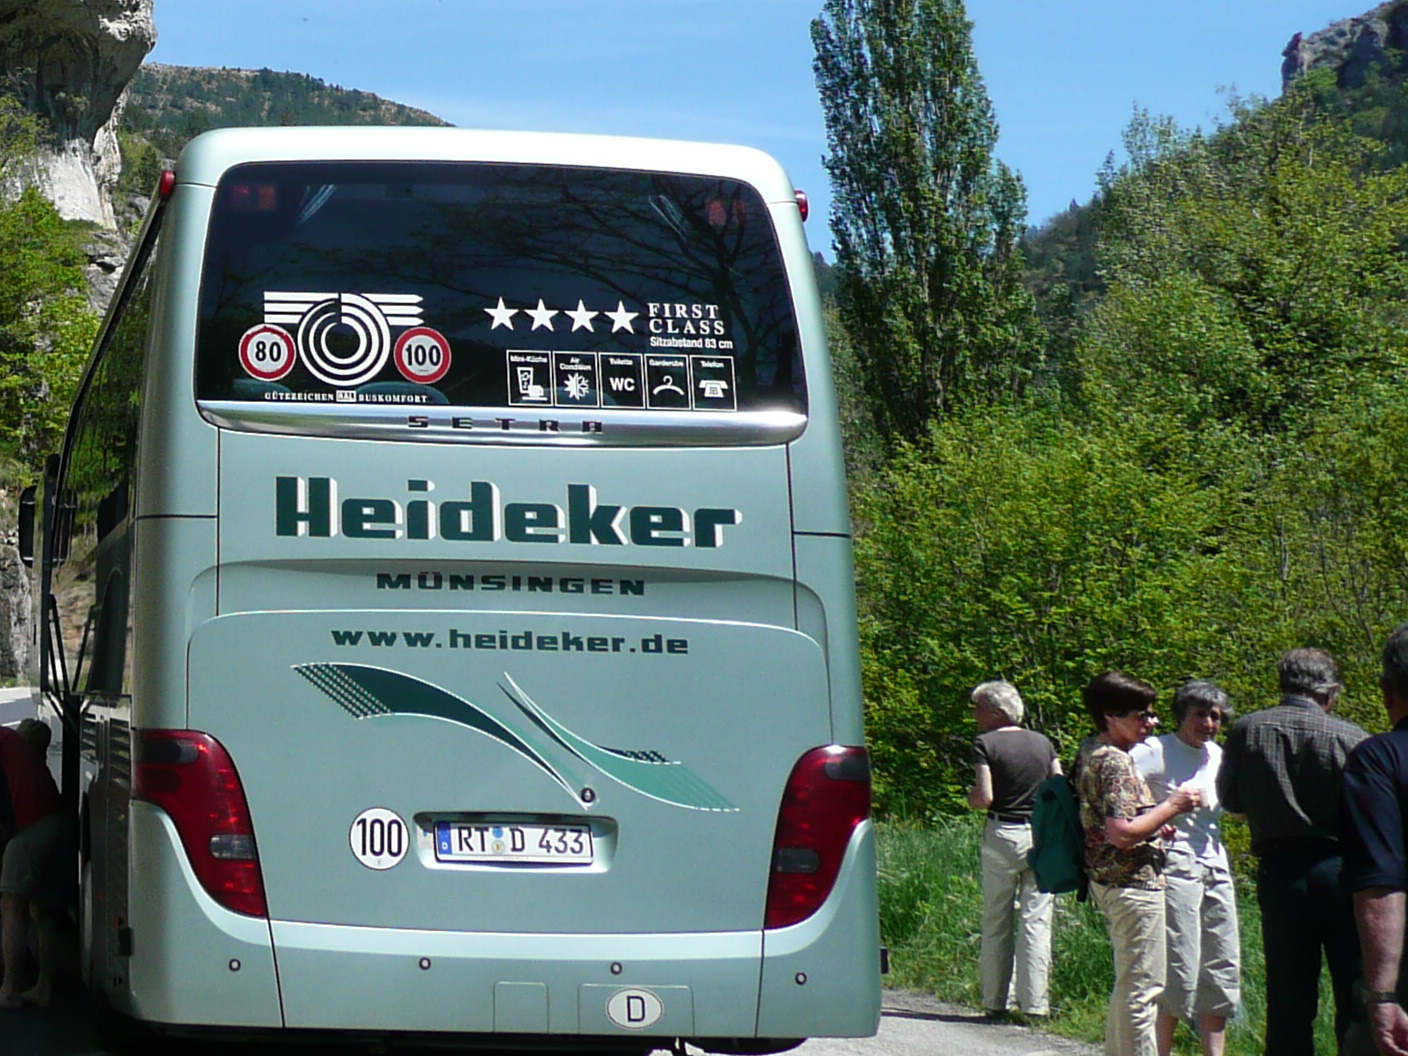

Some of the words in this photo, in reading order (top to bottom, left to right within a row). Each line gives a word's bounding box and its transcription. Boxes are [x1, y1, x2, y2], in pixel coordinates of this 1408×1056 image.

[647, 302, 719, 319] FIRST
[649, 318, 725, 335] CLASS
[255, 340, 281, 362] 80
[405, 344, 441, 366] 100
[718, 340, 733, 349] cm
[609, 377, 635, 392] WC
[264, 390, 334, 401] GÜTEZEICHEN
[358, 393, 428, 403] BUSKOMFORT
[408, 415, 603, 433] SETRA
[275, 475, 743, 548] Heideker
[376, 571, 645, 596] MÜNSINGEN
[331, 629, 689, 655] www.heideker.de
[356, 817, 403, 858] 100
[458, 826, 489, 852] RT
[509, 827, 525, 853] D
[538, 828, 584, 854] 433
[626, 995, 646, 1023] D
